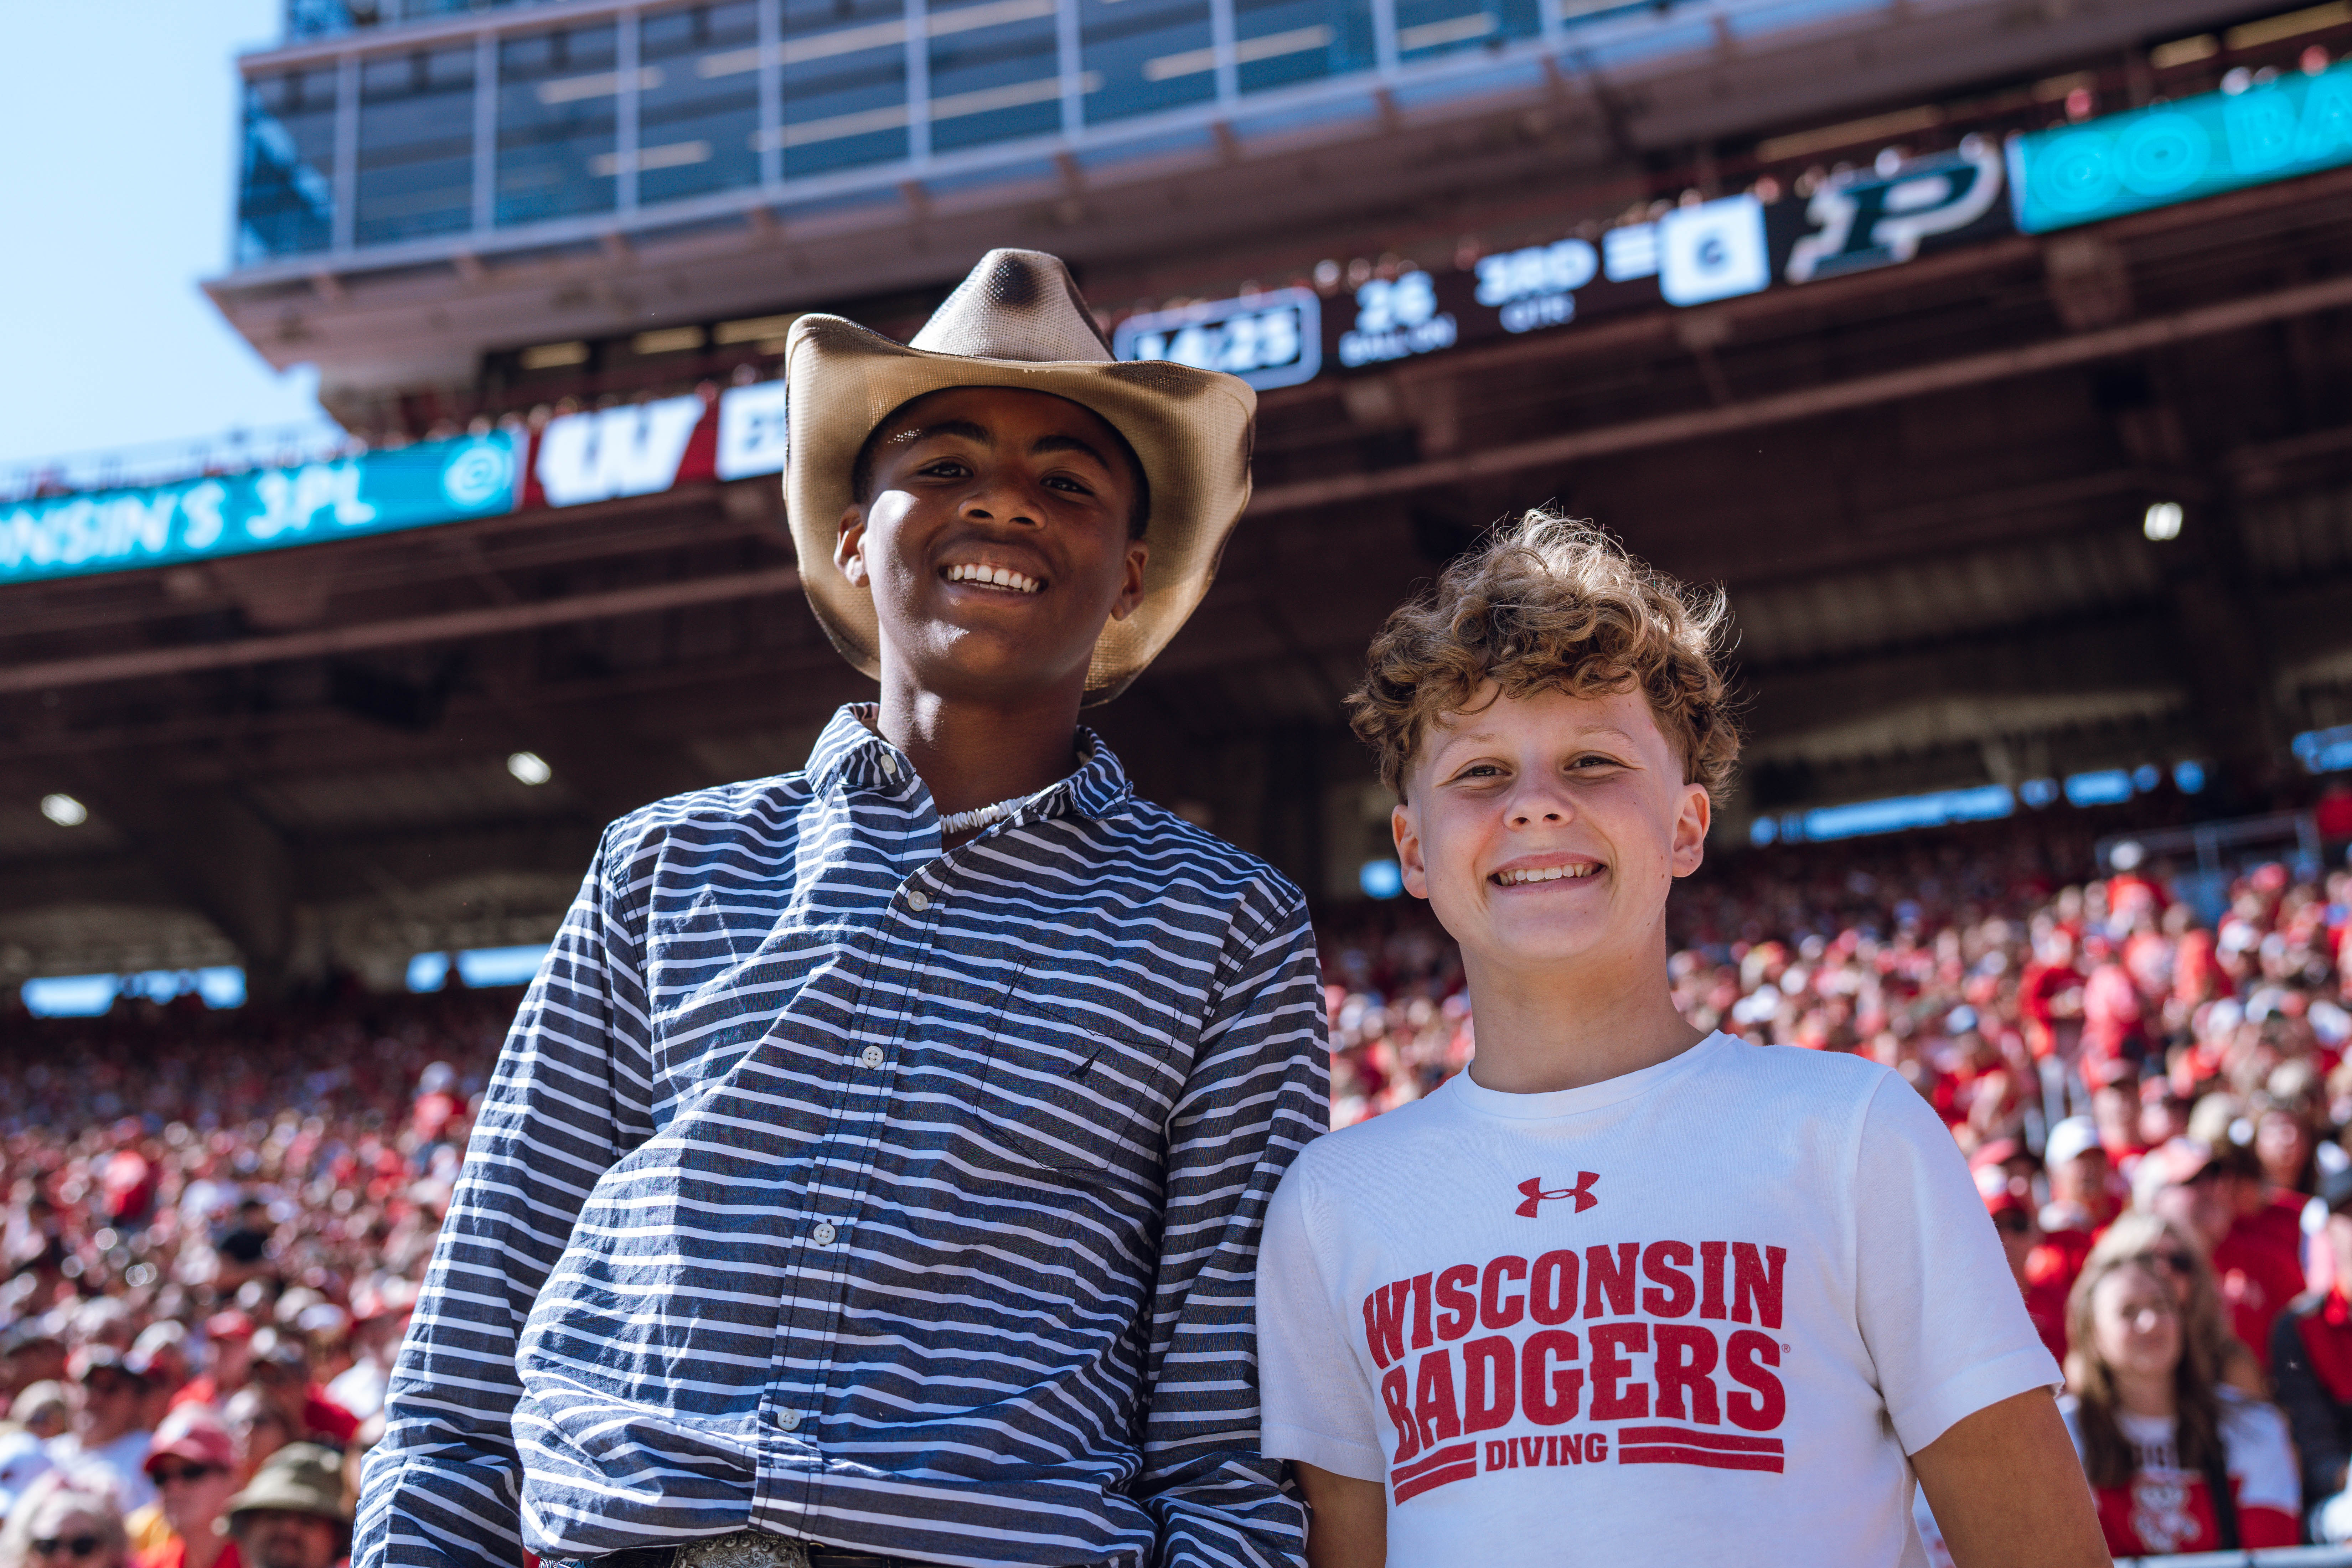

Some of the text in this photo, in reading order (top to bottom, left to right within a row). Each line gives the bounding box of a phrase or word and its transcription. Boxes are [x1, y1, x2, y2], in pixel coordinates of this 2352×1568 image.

[1363, 1240, 1786, 1369] WISCONSIN
[1381, 1322, 1785, 1465] BADGERS
[1485, 1433, 1608, 1472] DIVING
